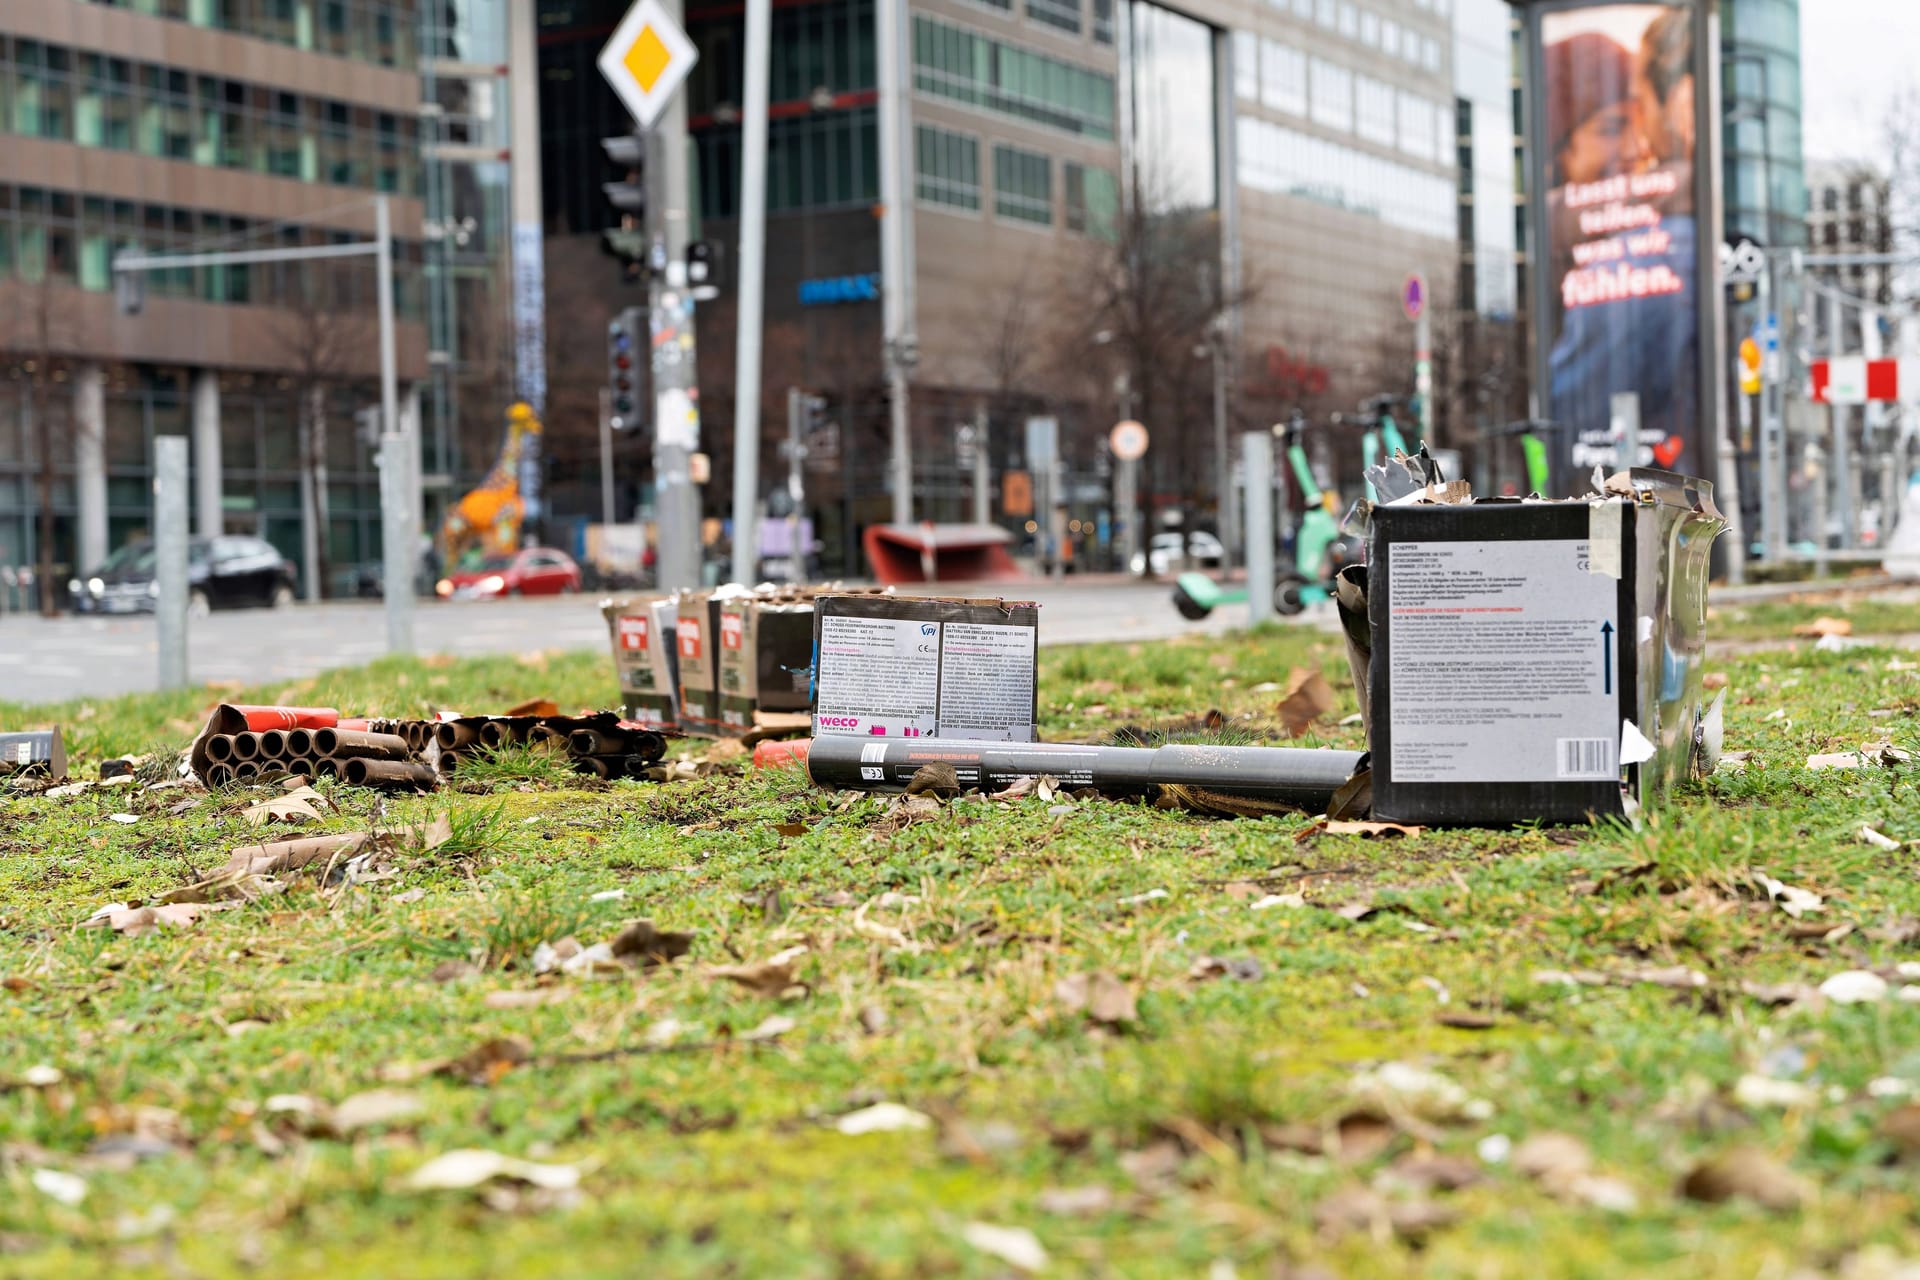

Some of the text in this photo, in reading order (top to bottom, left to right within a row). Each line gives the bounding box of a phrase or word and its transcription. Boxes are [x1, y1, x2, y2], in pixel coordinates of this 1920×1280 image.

[1564, 171, 1676, 209] Lasst uns
[1580, 203, 1661, 236] teilen,
[1573, 227, 1671, 266] was wir
[1562, 263, 1684, 308] fühlen.
[819, 716, 858, 727] weco
